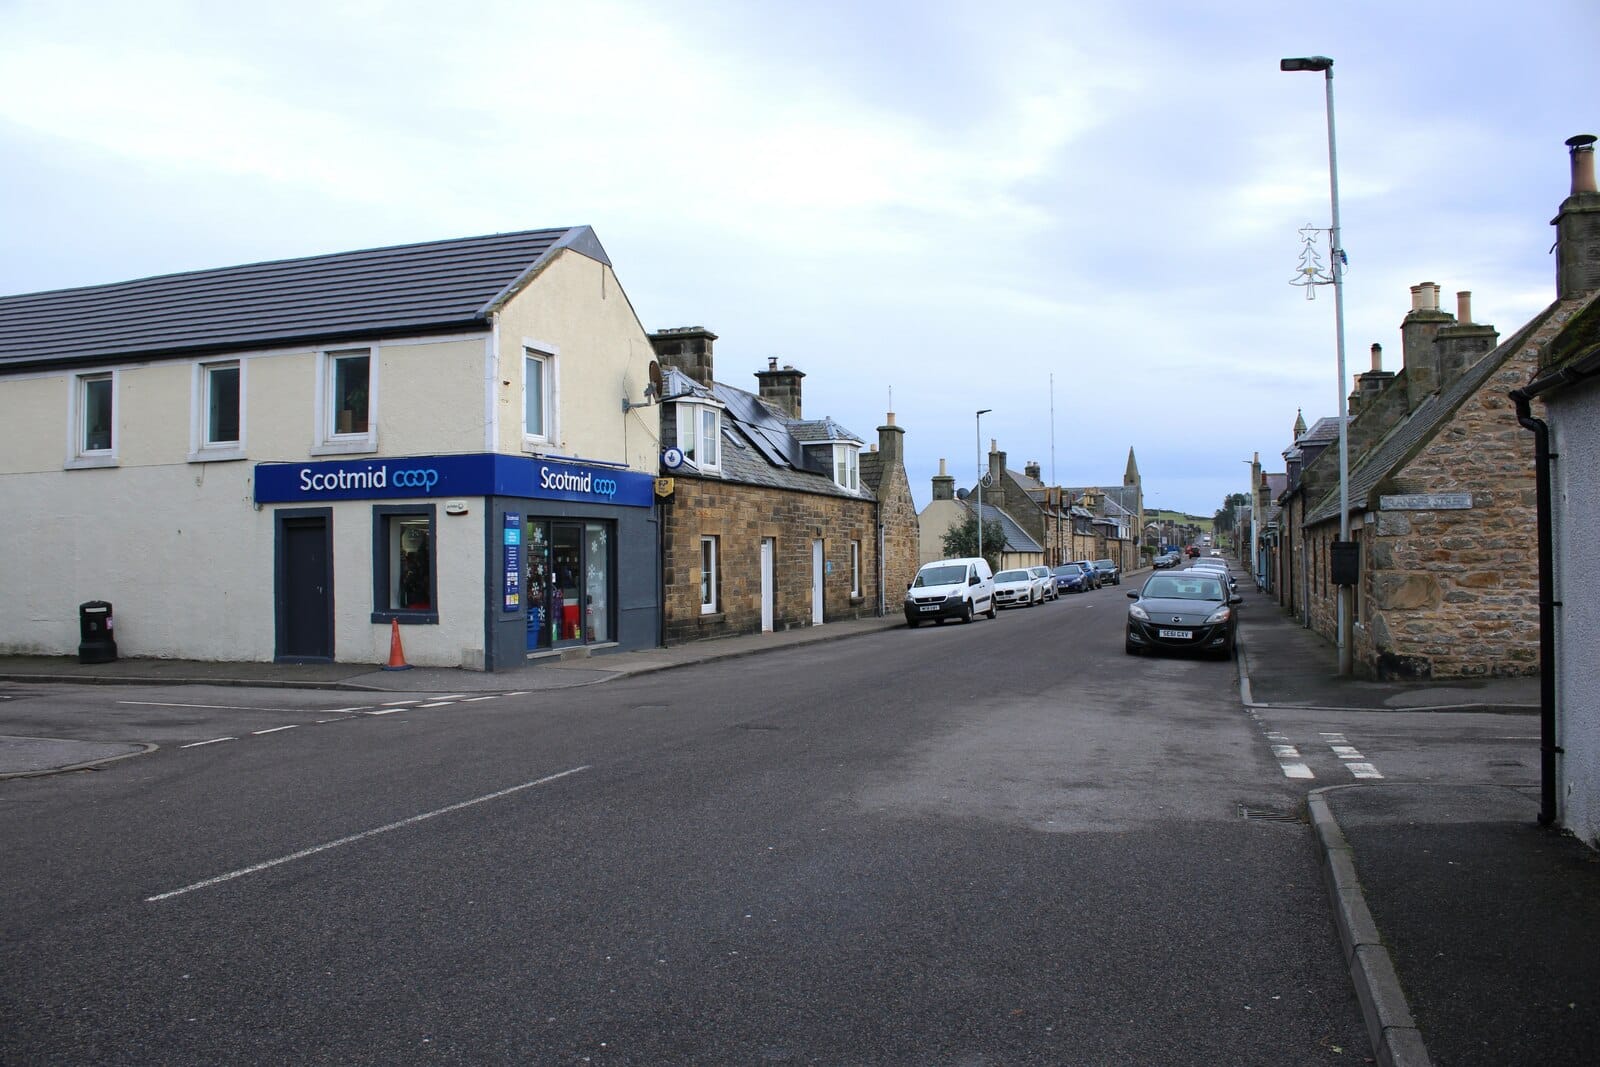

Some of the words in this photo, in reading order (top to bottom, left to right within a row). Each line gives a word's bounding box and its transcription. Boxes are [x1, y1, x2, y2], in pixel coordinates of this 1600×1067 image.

[300, 465, 387, 491] Scotmid
[392, 469, 438, 493] coop
[540, 466, 591, 492] Scotmid
[593, 478, 617, 500] coop
